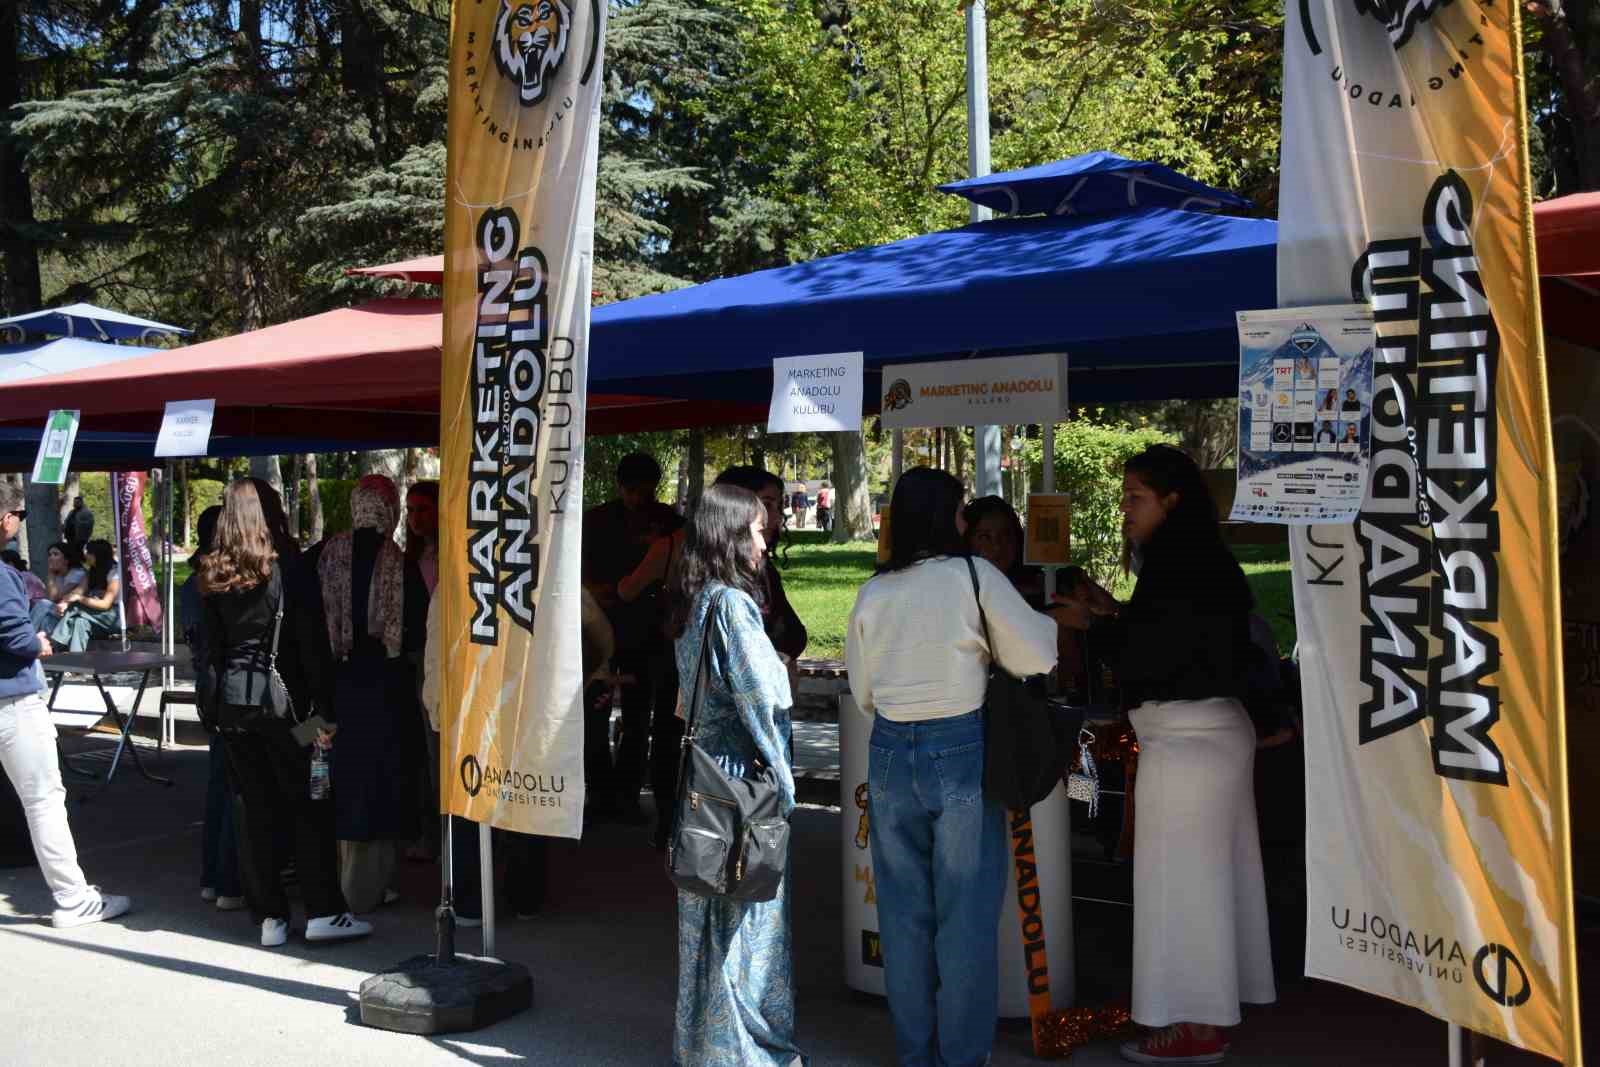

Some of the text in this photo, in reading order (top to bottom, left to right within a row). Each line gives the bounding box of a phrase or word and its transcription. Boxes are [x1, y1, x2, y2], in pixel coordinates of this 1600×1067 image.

[787, 366, 846, 379] MARKETING
[789, 385, 841, 398] ANADOLU
[919, 379, 1055, 398] MARKETING ANADOLU
[468, 207, 519, 645] MARKETING
[501, 248, 548, 633] ANADOLU
[542, 336, 575, 514] KULÜBÜ
[484, 766, 565, 793] ANADOLU
[1007, 808, 1049, 995] ANADOLU
